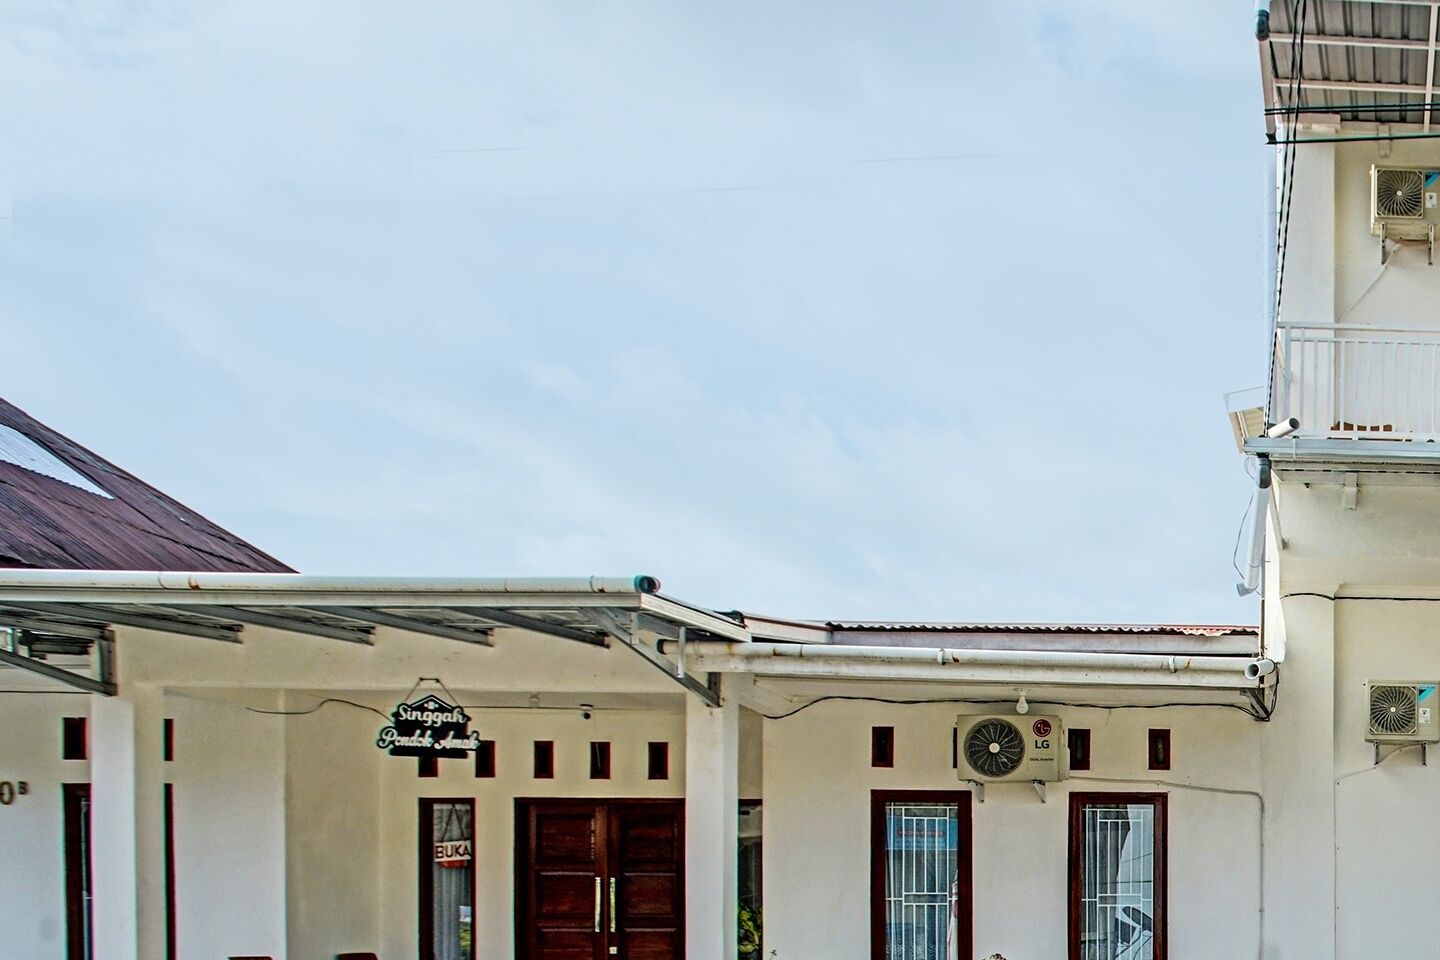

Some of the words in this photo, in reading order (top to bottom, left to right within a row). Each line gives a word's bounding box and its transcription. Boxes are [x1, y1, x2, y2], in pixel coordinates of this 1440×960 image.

[398, 705, 467, 727] Singgah
[378, 728, 434, 748] Pondok
[1035, 740, 1050, 749] LG
[435, 844, 472, 858] BUKA
